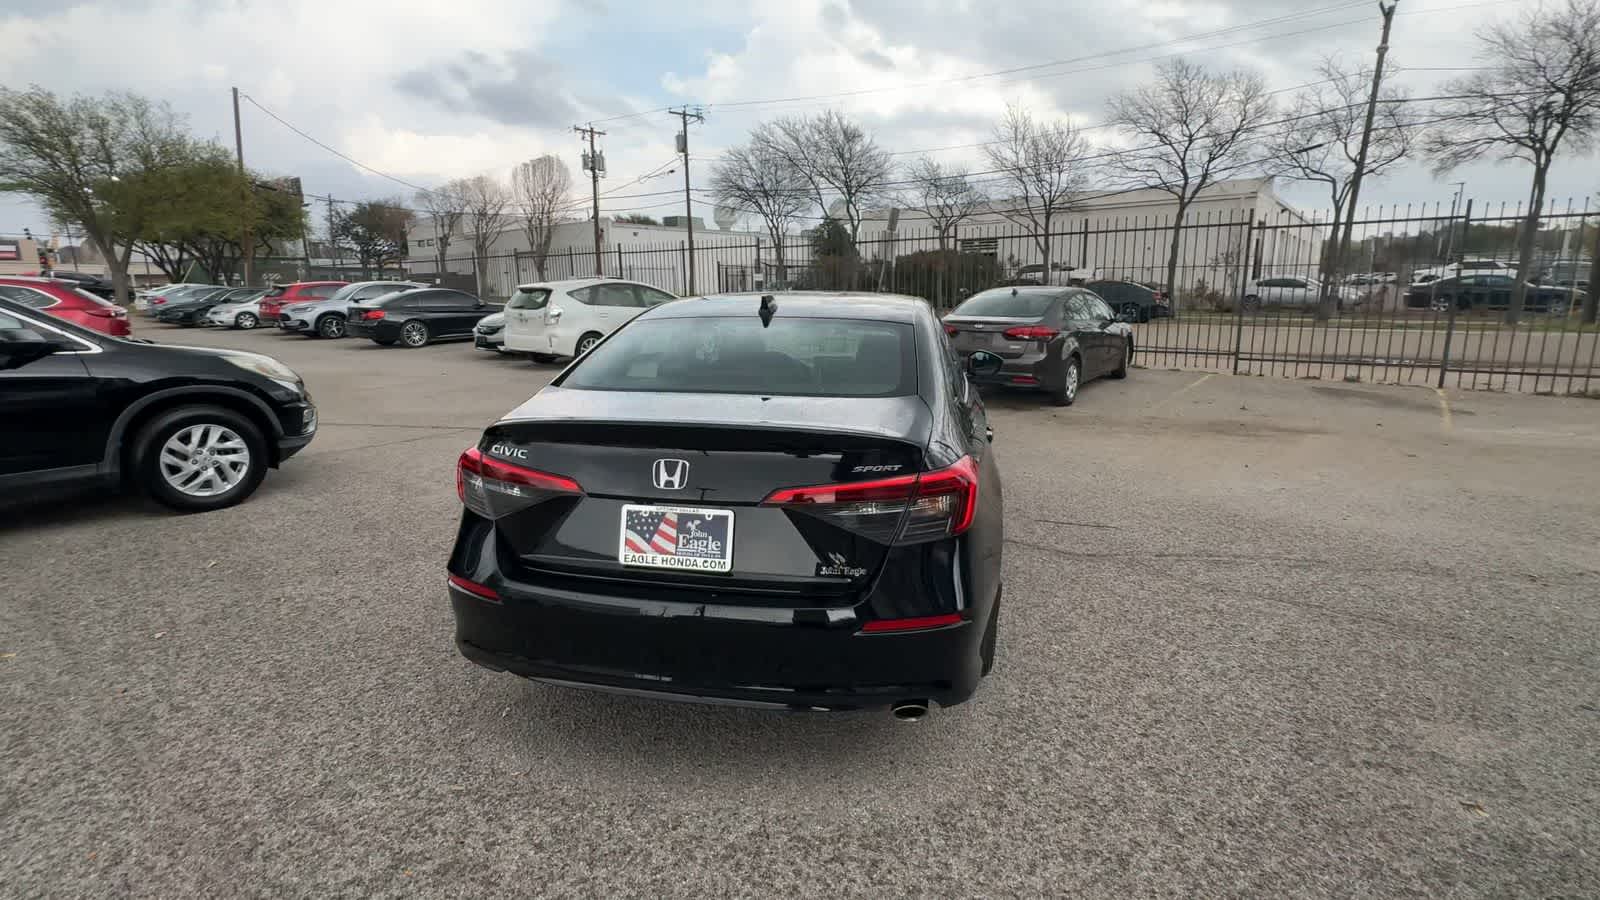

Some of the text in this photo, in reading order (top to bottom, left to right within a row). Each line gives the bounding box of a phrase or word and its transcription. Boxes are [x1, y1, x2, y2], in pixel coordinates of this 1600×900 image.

[492, 444, 528, 459] CIVIC
[851, 464, 903, 473] SPORT
[690, 529, 708, 538] John
[678, 534, 721, 553] Eagle
[624, 554, 726, 569] EAGLE HONDA.COM
